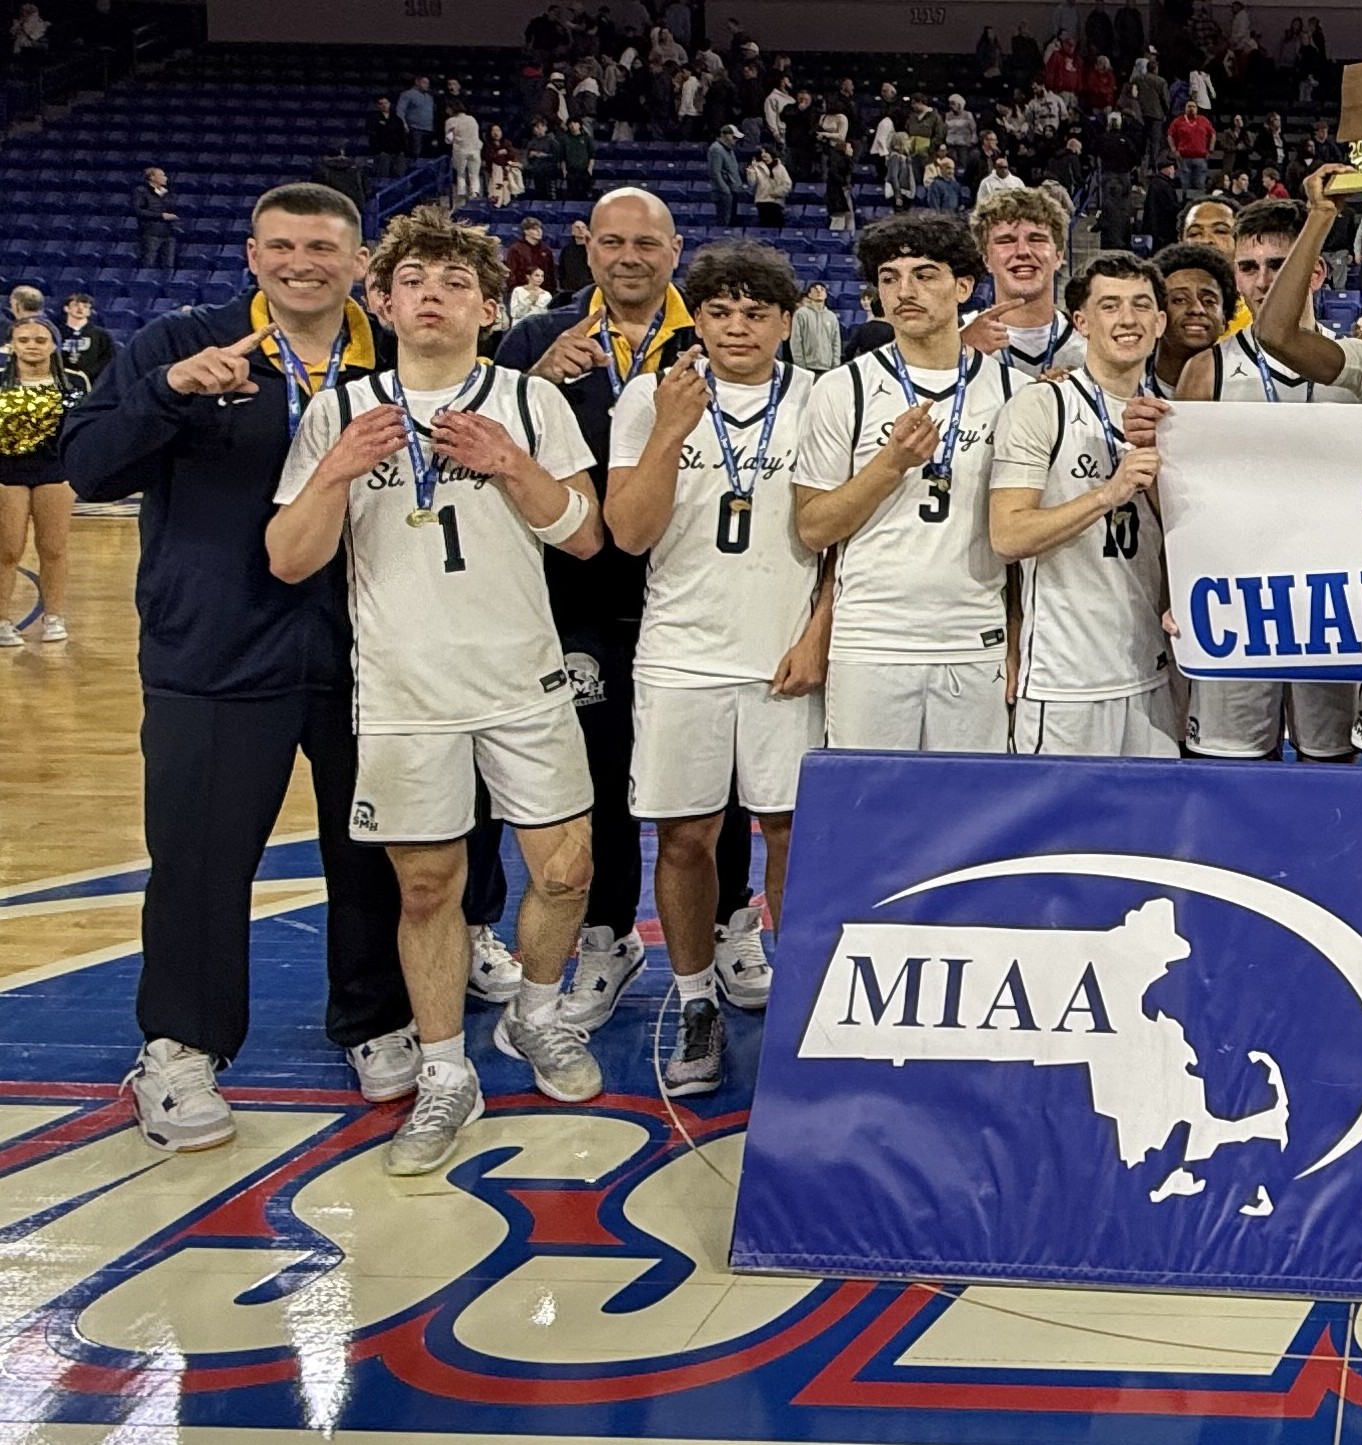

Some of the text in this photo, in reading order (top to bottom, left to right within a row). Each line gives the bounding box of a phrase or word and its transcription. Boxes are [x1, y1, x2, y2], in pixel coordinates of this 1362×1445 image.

[911, 7, 946, 25] 117
[367, 461, 405, 490] St.
[1070, 453, 1101, 479] St.
[918, 462, 952, 523] 3
[438, 504, 467, 574] 1
[715, 490, 753, 554] 0
[1103, 501, 1139, 560] 10
[567, 680, 606, 697] MH
[353, 815, 378, 832] SMH
[836, 955, 1118, 1035] MIAA
